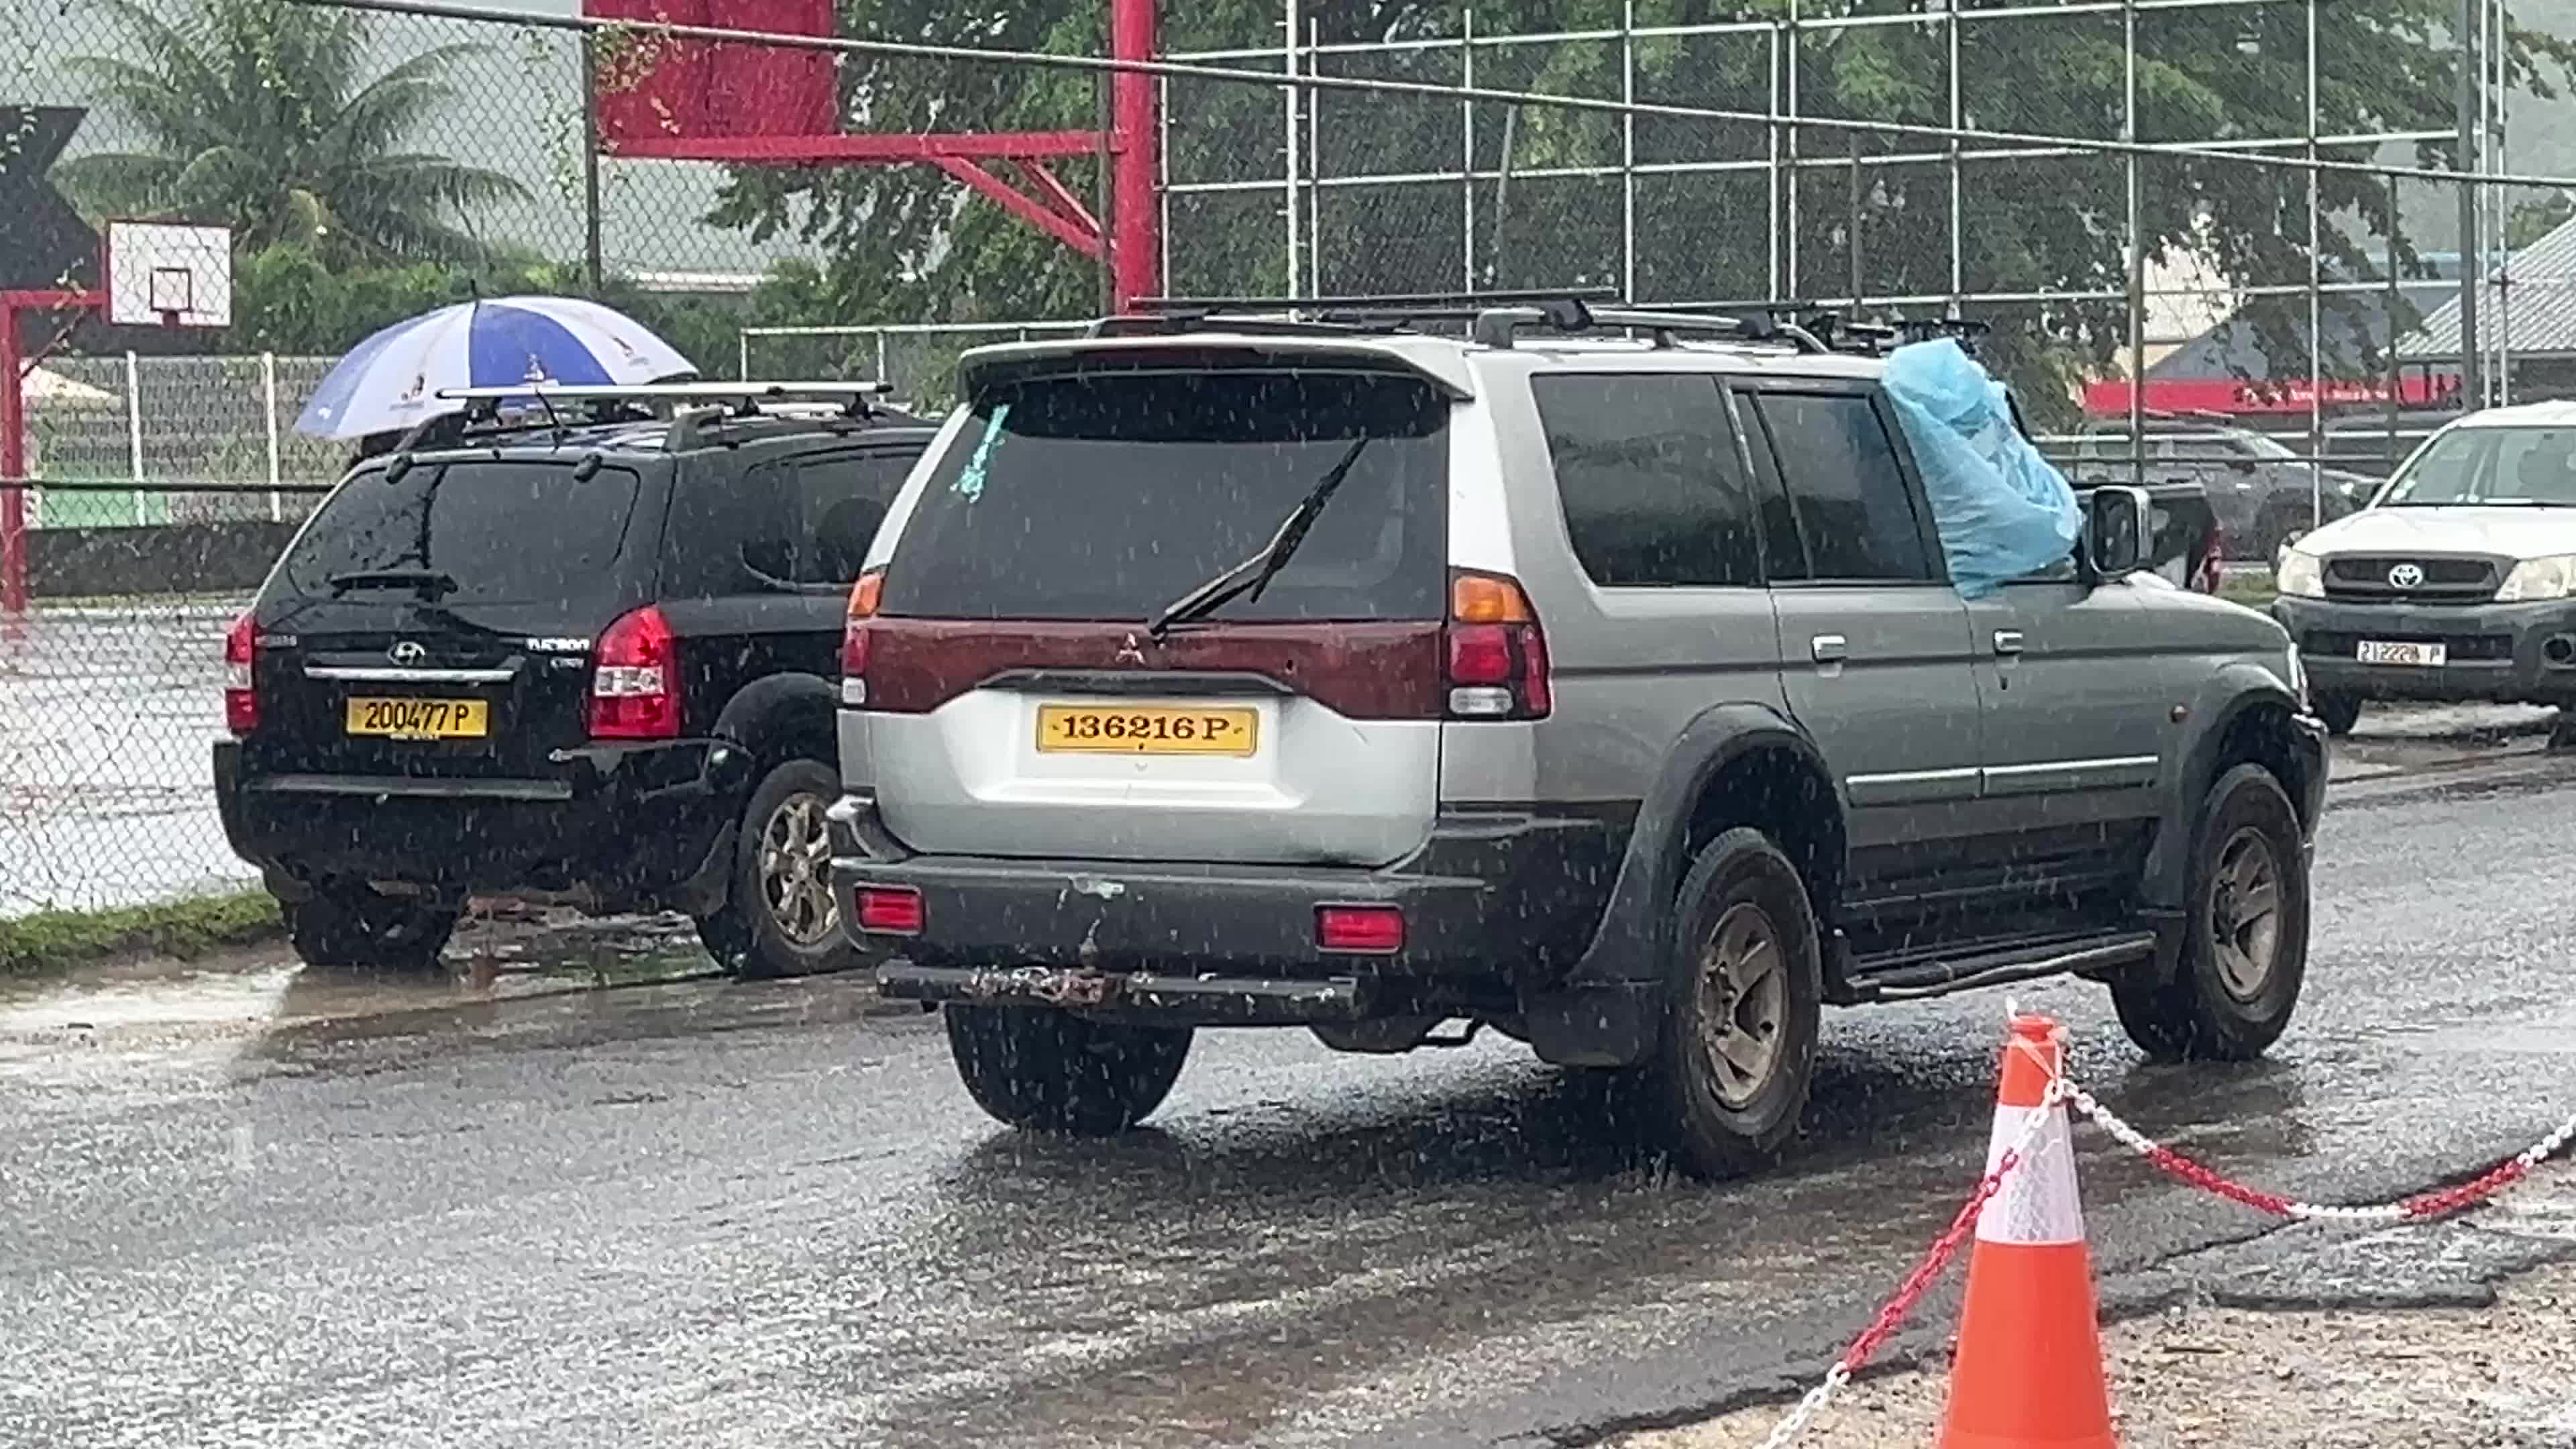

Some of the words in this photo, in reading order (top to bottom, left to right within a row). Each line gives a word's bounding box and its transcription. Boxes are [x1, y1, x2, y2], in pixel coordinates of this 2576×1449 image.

[364, 702, 449, 731] 200477
[453, 704, 470, 731] P
[1063, 714, 1195, 740] 136216
[1201, 717, 1230, 741] P
